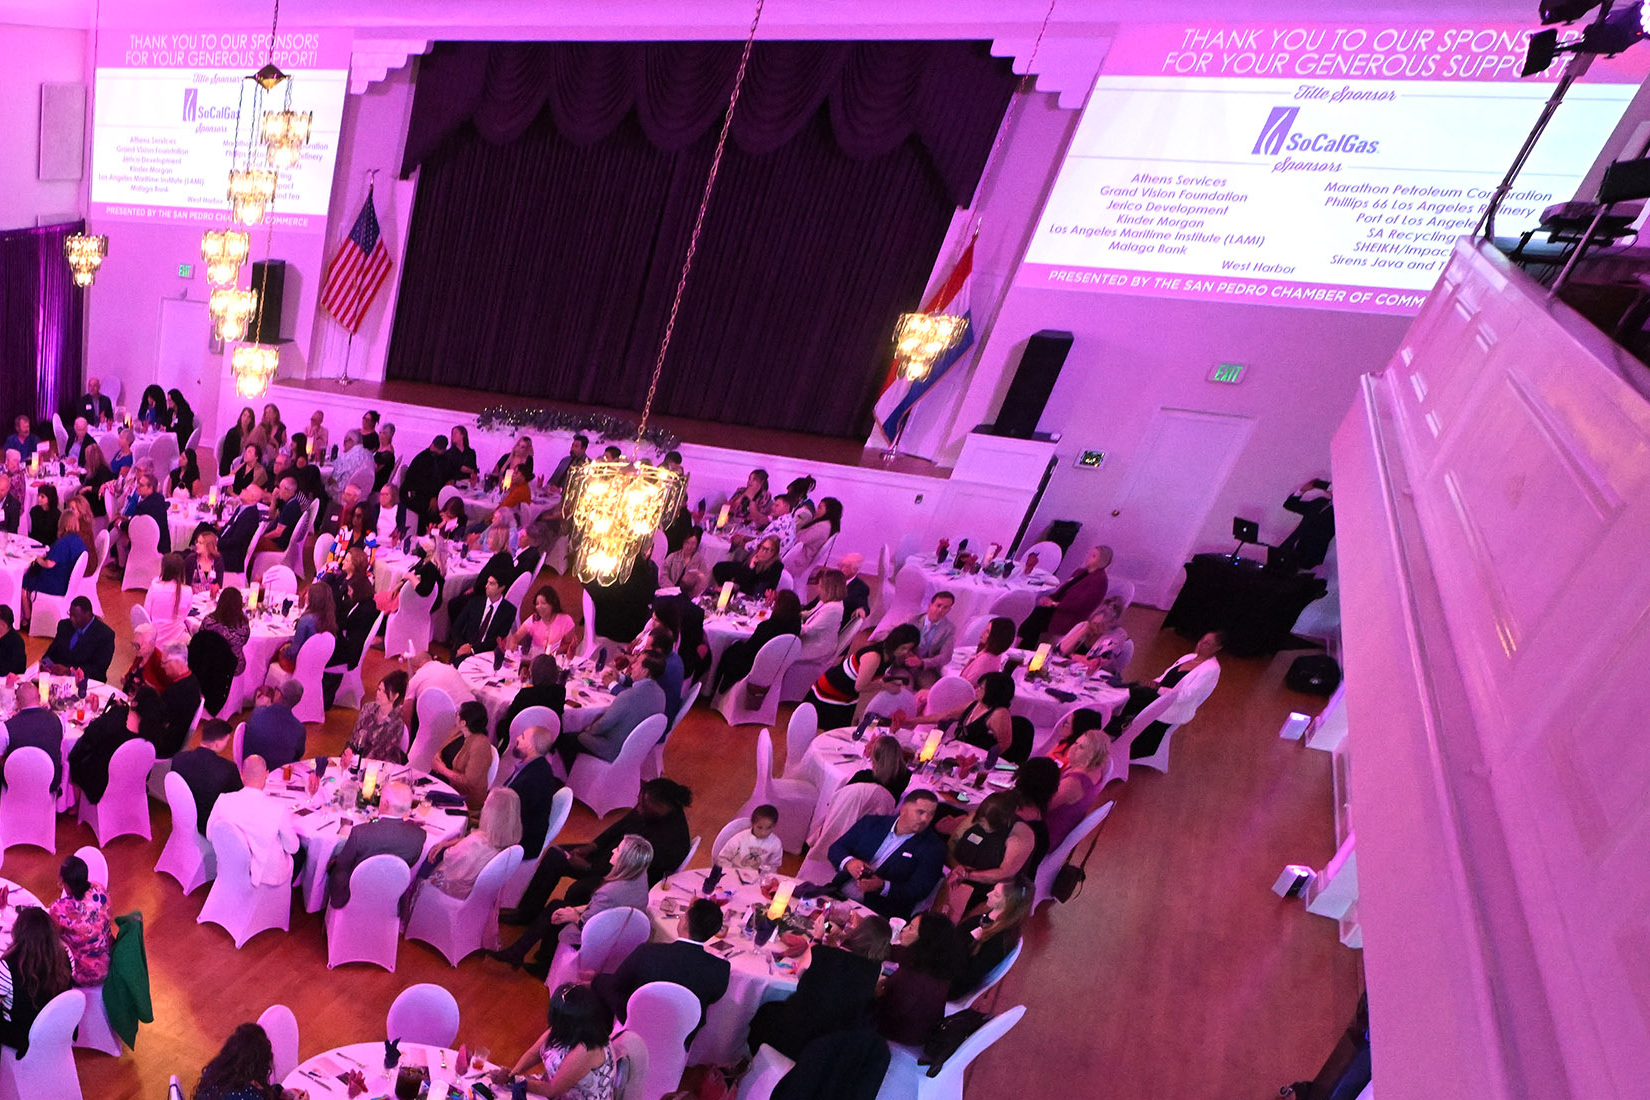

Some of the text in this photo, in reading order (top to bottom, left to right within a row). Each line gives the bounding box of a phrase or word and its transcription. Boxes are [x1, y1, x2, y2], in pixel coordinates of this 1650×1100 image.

[130, 34, 319, 50] THANK YOU TO OUR SPONSORS
[1181, 28, 1264, 49] THANK
[1270, 28, 1327, 51] YOU
[1331, 28, 1367, 51] TO
[1373, 28, 1435, 51] OUR
[125, 51, 149, 65] FOR
[152, 51, 185, 66] YOUR
[187, 51, 254, 66] GENEROUS
[1162, 51, 1213, 73] FOR
[1221, 52, 1290, 74] YOUR
[1294, 53, 1441, 77] GENEROUS
[1294, 84, 1397, 104] Title Sponsor
[1286, 132, 1379, 154] SoCalGas
[1271, 156, 1342, 173] Sponsors
[1131, 173, 1227, 187] Athens Services
[1100, 185, 1248, 203] Grand Vision Foundation
[1324, 181, 1553, 202] Marathon Petroleum Cororation
[106, 207, 145, 216] PRESENTED
[147, 208, 157, 217] BY
[158, 209, 172, 218] THE
[173, 210, 188, 219] SAN
[190, 211, 214, 220] PEDRO
[1106, 200, 1229, 216] Jerico Development
[1324, 196, 1536, 218] Phillips 66 Los Angeles Rinery
[1116, 214, 1205, 230] Kinder Morgan
[1355, 212, 1478, 230] Port of Los Angele
[1049, 223, 1265, 248] Los Angeles Maritime Institute (LAMI)
[1366, 228, 1457, 244] SA Recycling
[1108, 241, 1188, 256] Malaga Bank
[1221, 260, 1296, 275] West Harbor
[1330, 254, 1367, 267] Sirens
[1371, 256, 1404, 269] Java
[1407, 259, 1434, 271] and
[1048, 270, 1427, 309] PRESENTED BY THE SAN PEDRO CHAMBER OF COMM
[1214, 364, 1243, 382] EXIT
